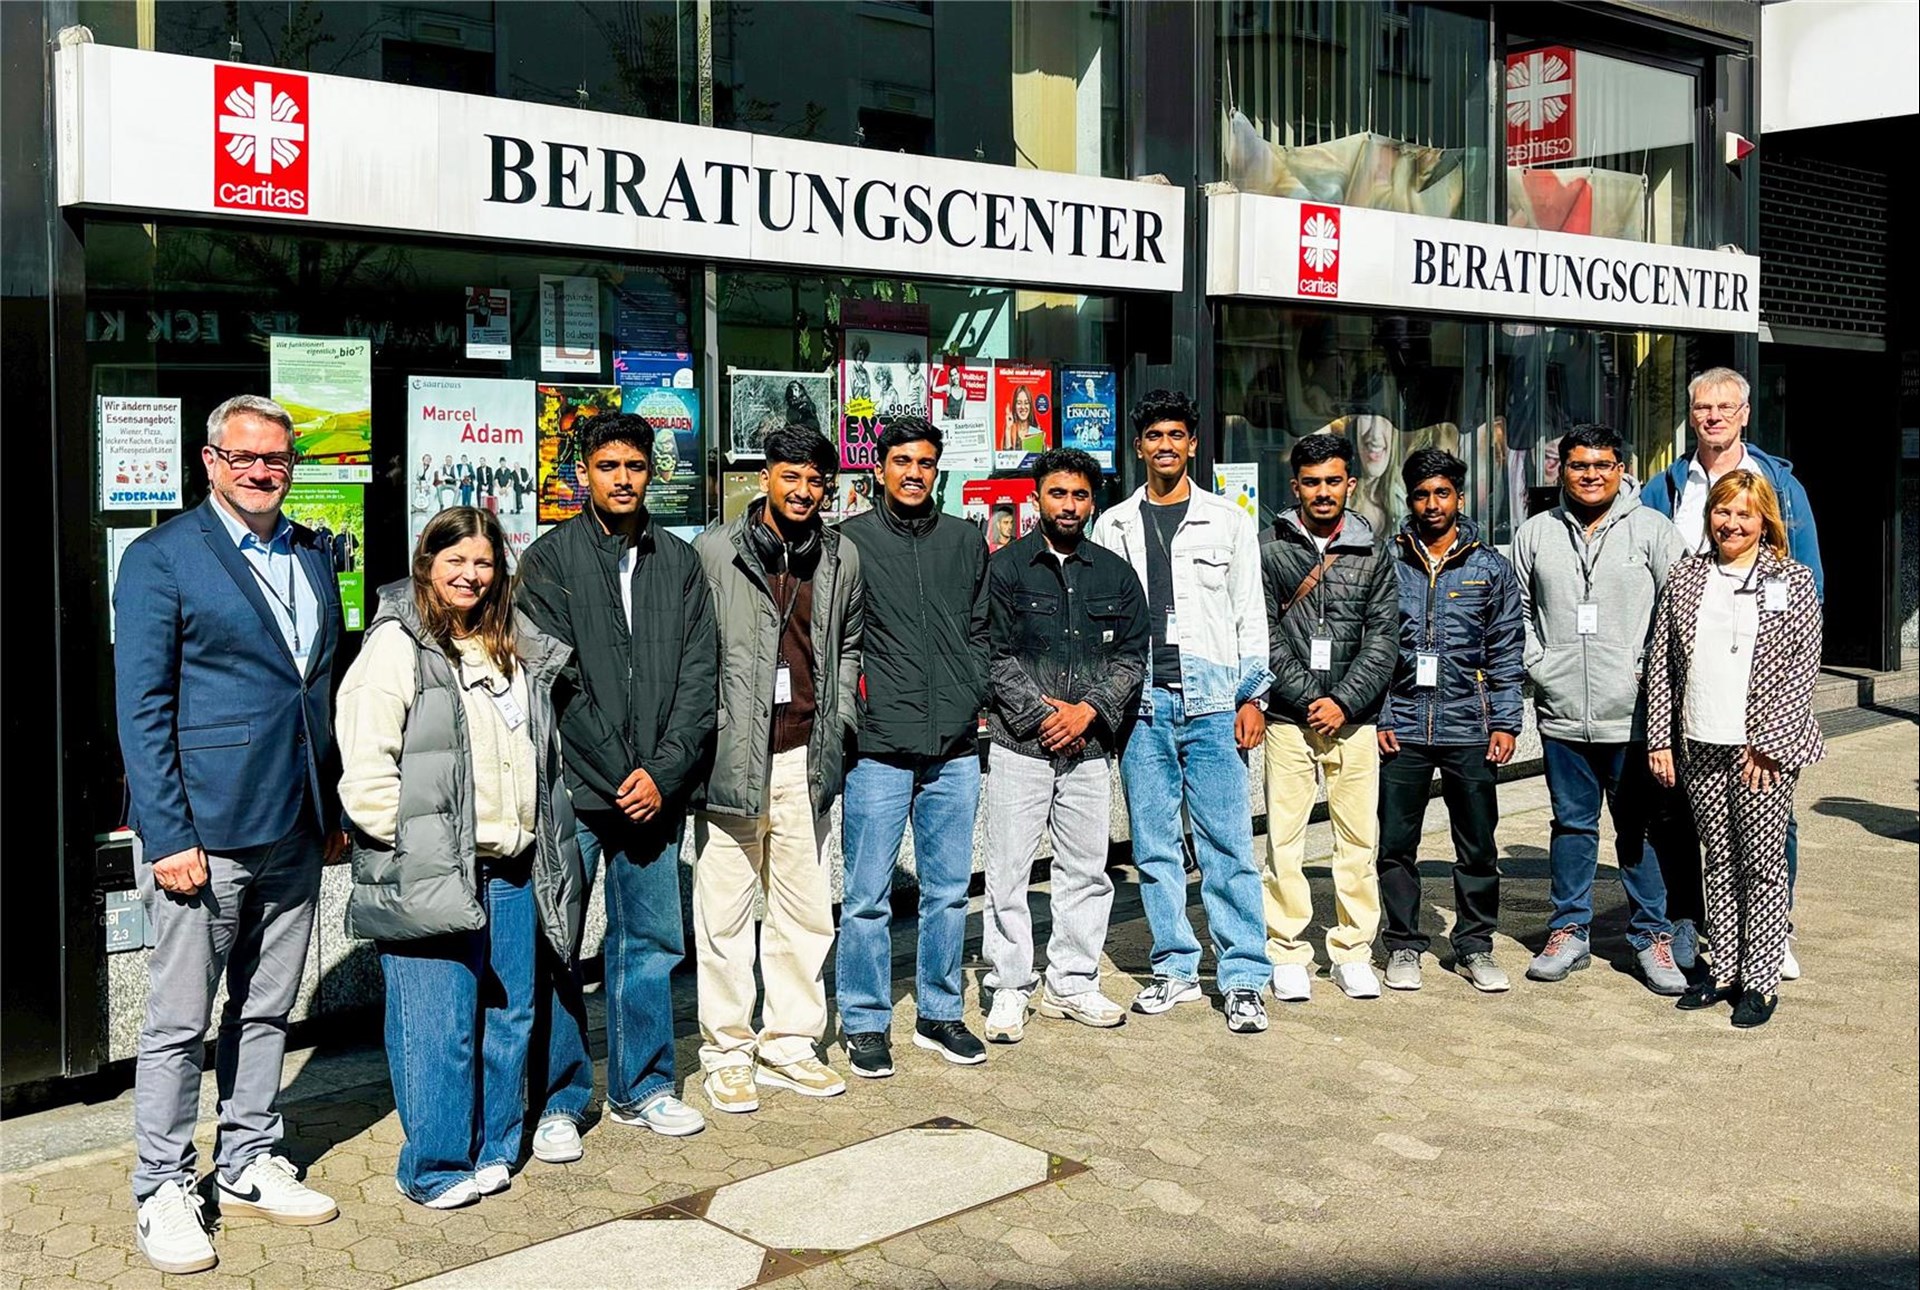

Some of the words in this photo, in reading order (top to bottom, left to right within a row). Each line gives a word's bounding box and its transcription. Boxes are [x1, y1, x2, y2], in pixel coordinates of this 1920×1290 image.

[219, 180, 304, 211] caritas
[483, 133, 1166, 264] BERATUNGSCENTER
[1412, 238, 1749, 312] BERATUNGSCENTER
[1300, 277, 1337, 295] caritas
[104, 401, 120, 411] Wir
[121, 401, 151, 411] ändern
[153, 403, 178, 411] unser
[422, 406, 477, 421] Marcel
[106, 413, 176, 426] Essensangebot:
[461, 423, 523, 444] Adam
[109, 491, 176, 502] JEDERMAN
[122, 889, 141, 902] 150
